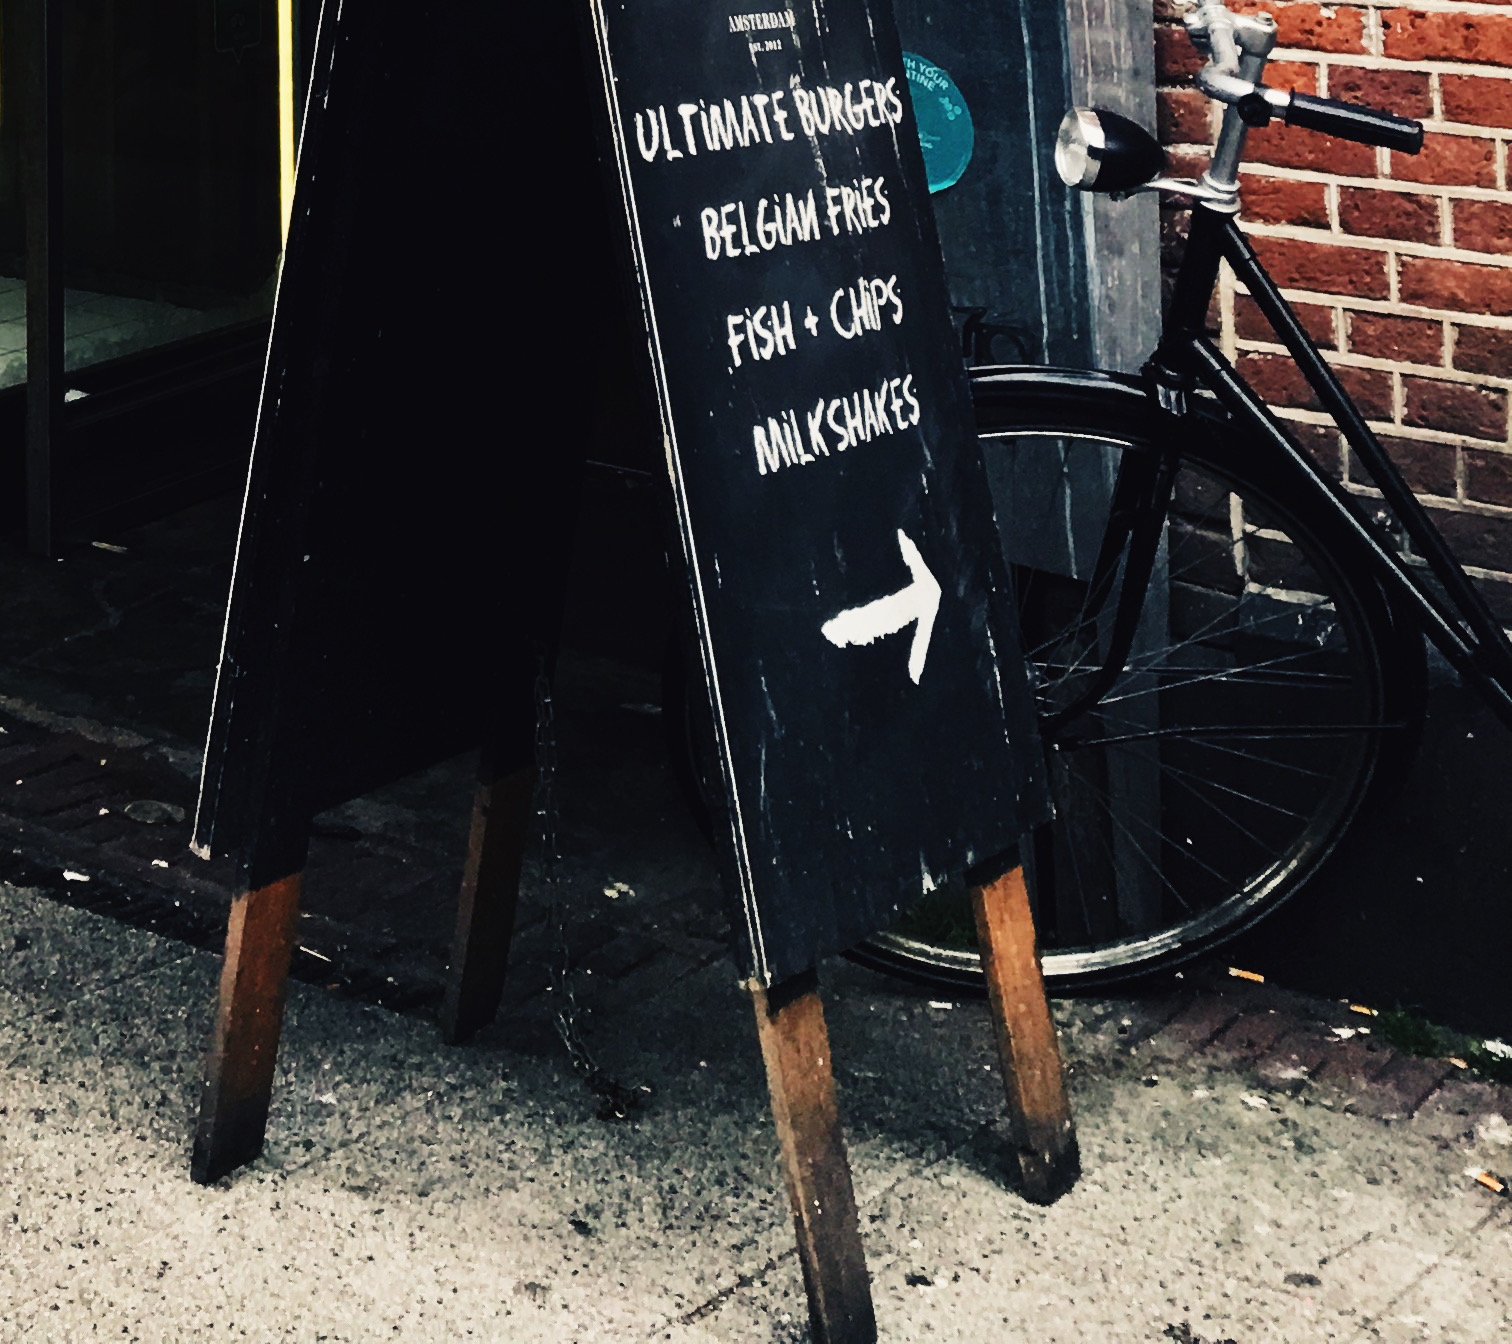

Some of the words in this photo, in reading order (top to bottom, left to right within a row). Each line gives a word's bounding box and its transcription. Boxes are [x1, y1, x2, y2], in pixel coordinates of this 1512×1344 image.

[729, 9, 796, 33] AMSTERDAM
[919, 63, 949, 90] YOUR
[793, 76, 903, 136] BURGERS
